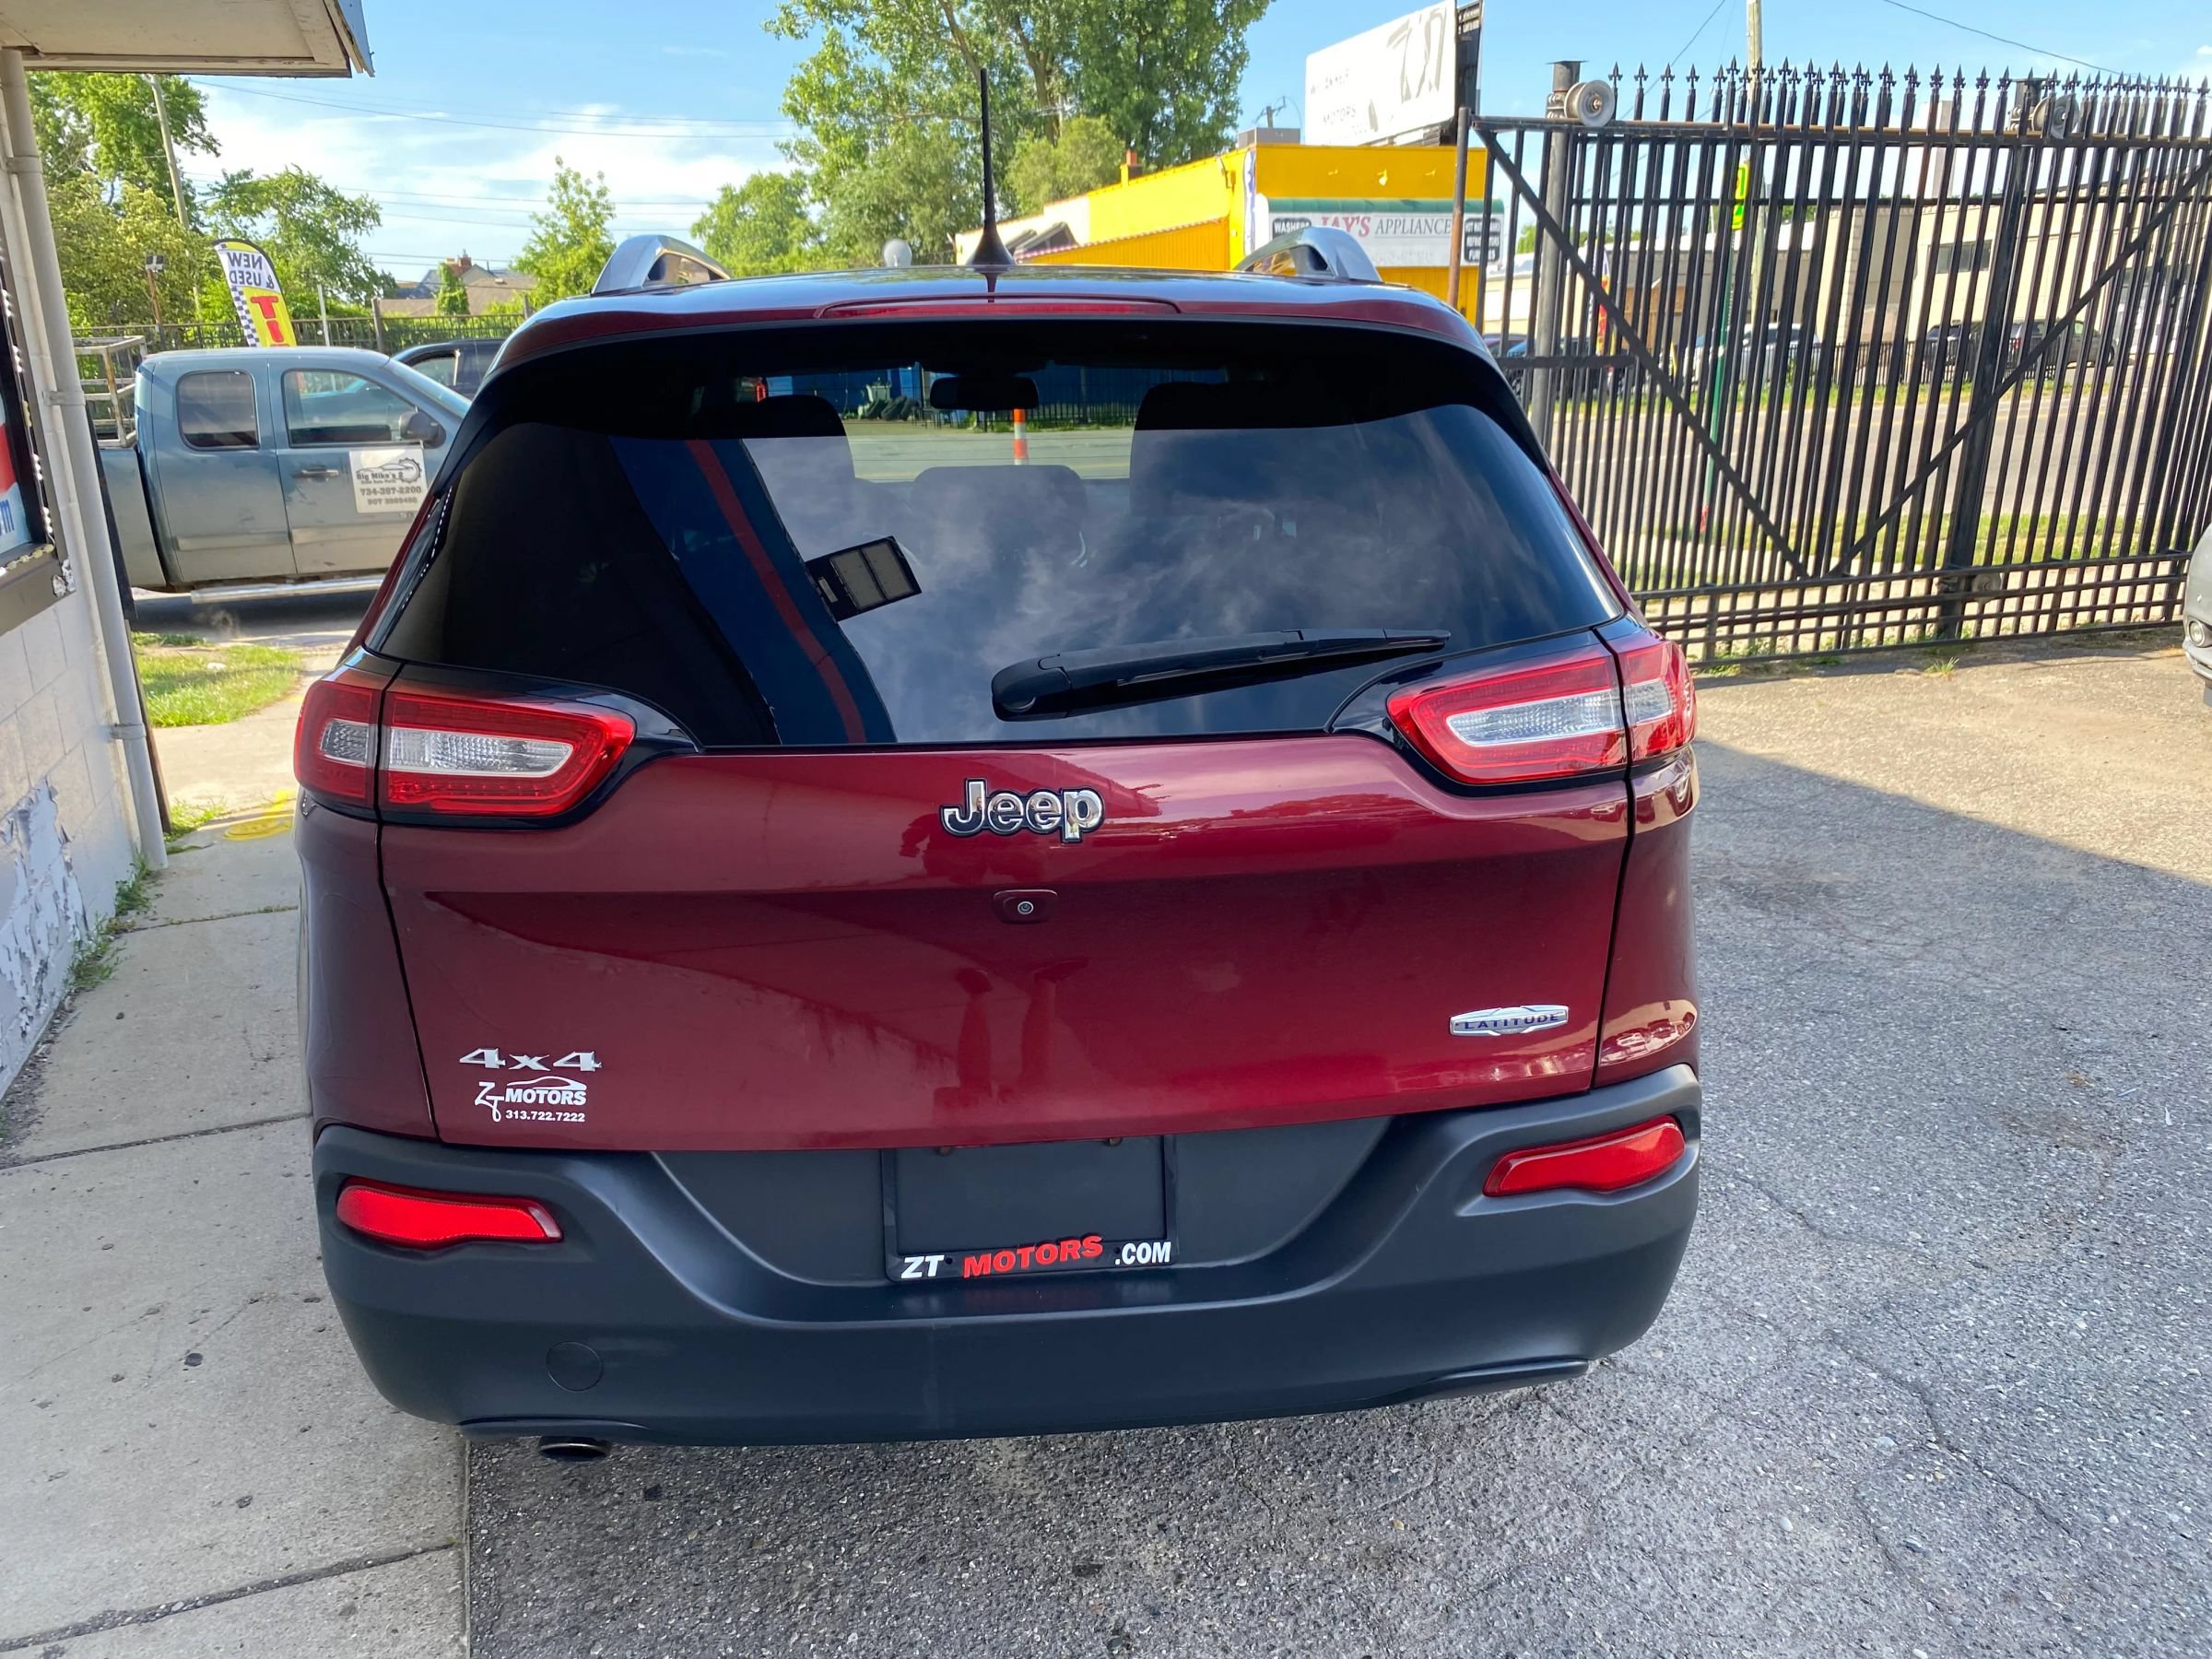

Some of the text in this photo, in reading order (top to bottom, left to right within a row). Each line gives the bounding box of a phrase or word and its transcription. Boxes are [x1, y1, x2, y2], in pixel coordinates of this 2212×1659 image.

[1374, 218, 1452, 236] APPLIANCE
[940, 778, 1105, 842] Jeep
[1464, 1014, 1559, 1030] LATITUDE
[505, 1088, 587, 1106] MOTORS
[505, 1110, 585, 1123] 313.722.7222
[900, 1234, 1171, 1279] ZT MOTORS .COM
